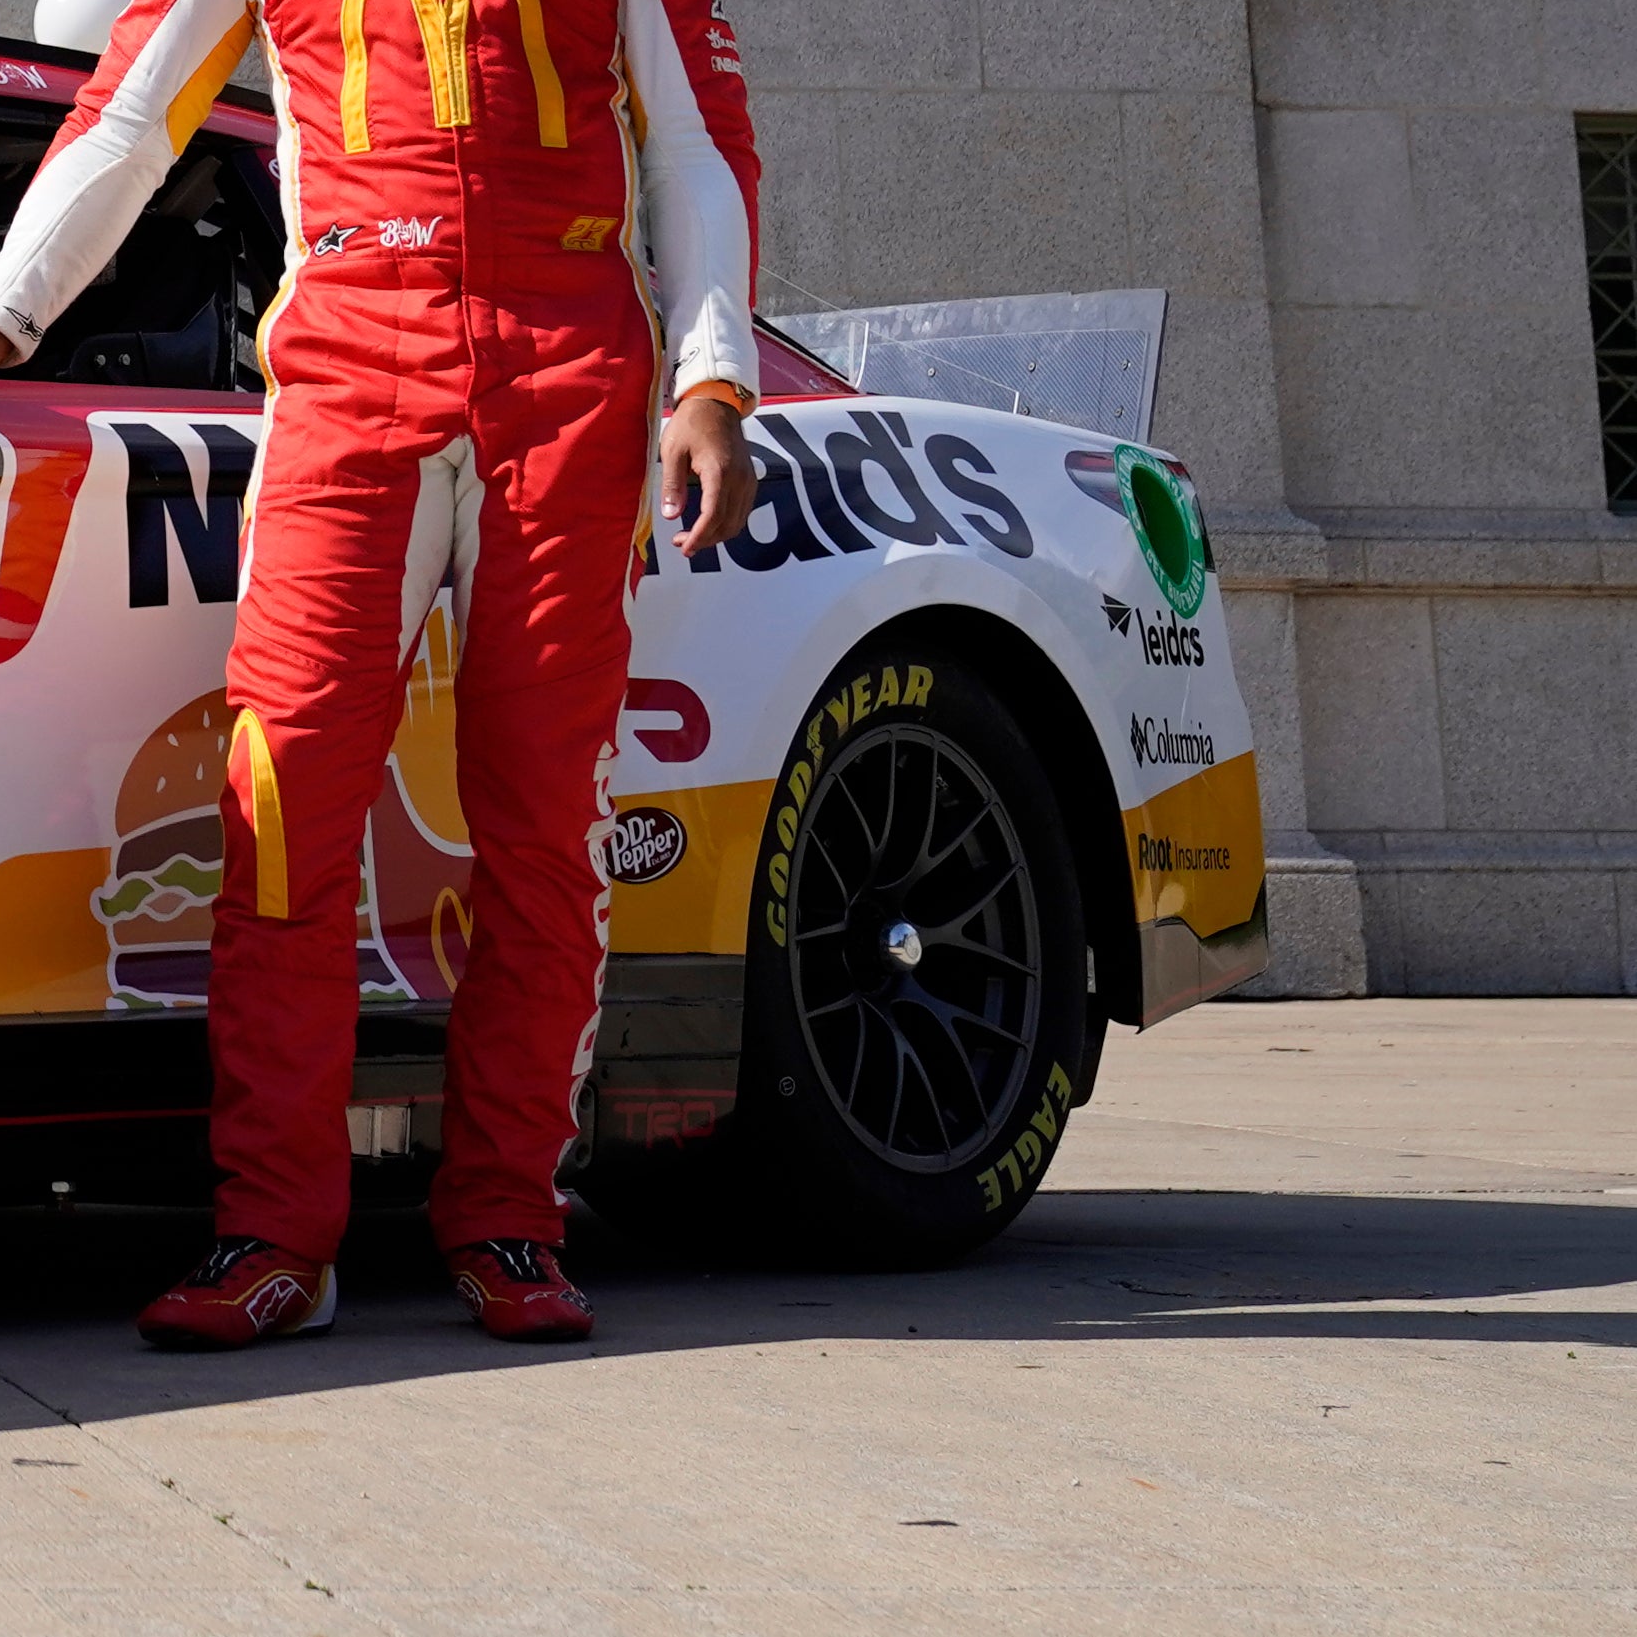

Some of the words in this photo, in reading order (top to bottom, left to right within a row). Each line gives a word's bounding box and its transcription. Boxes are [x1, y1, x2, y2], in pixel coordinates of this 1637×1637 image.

[559, 215, 619, 252] 23
[1135, 607, 1205, 667] leidos
[1143, 716, 1215, 765] Columbia
[627, 816, 656, 847] Dr
[766, 664, 934, 949] GOODYEAR
[611, 824, 676, 875] Pepper
[1138, 833, 1173, 871] Root
[1175, 844, 1231, 871] Insurance
[976, 1061, 1073, 1214] EAGLE
